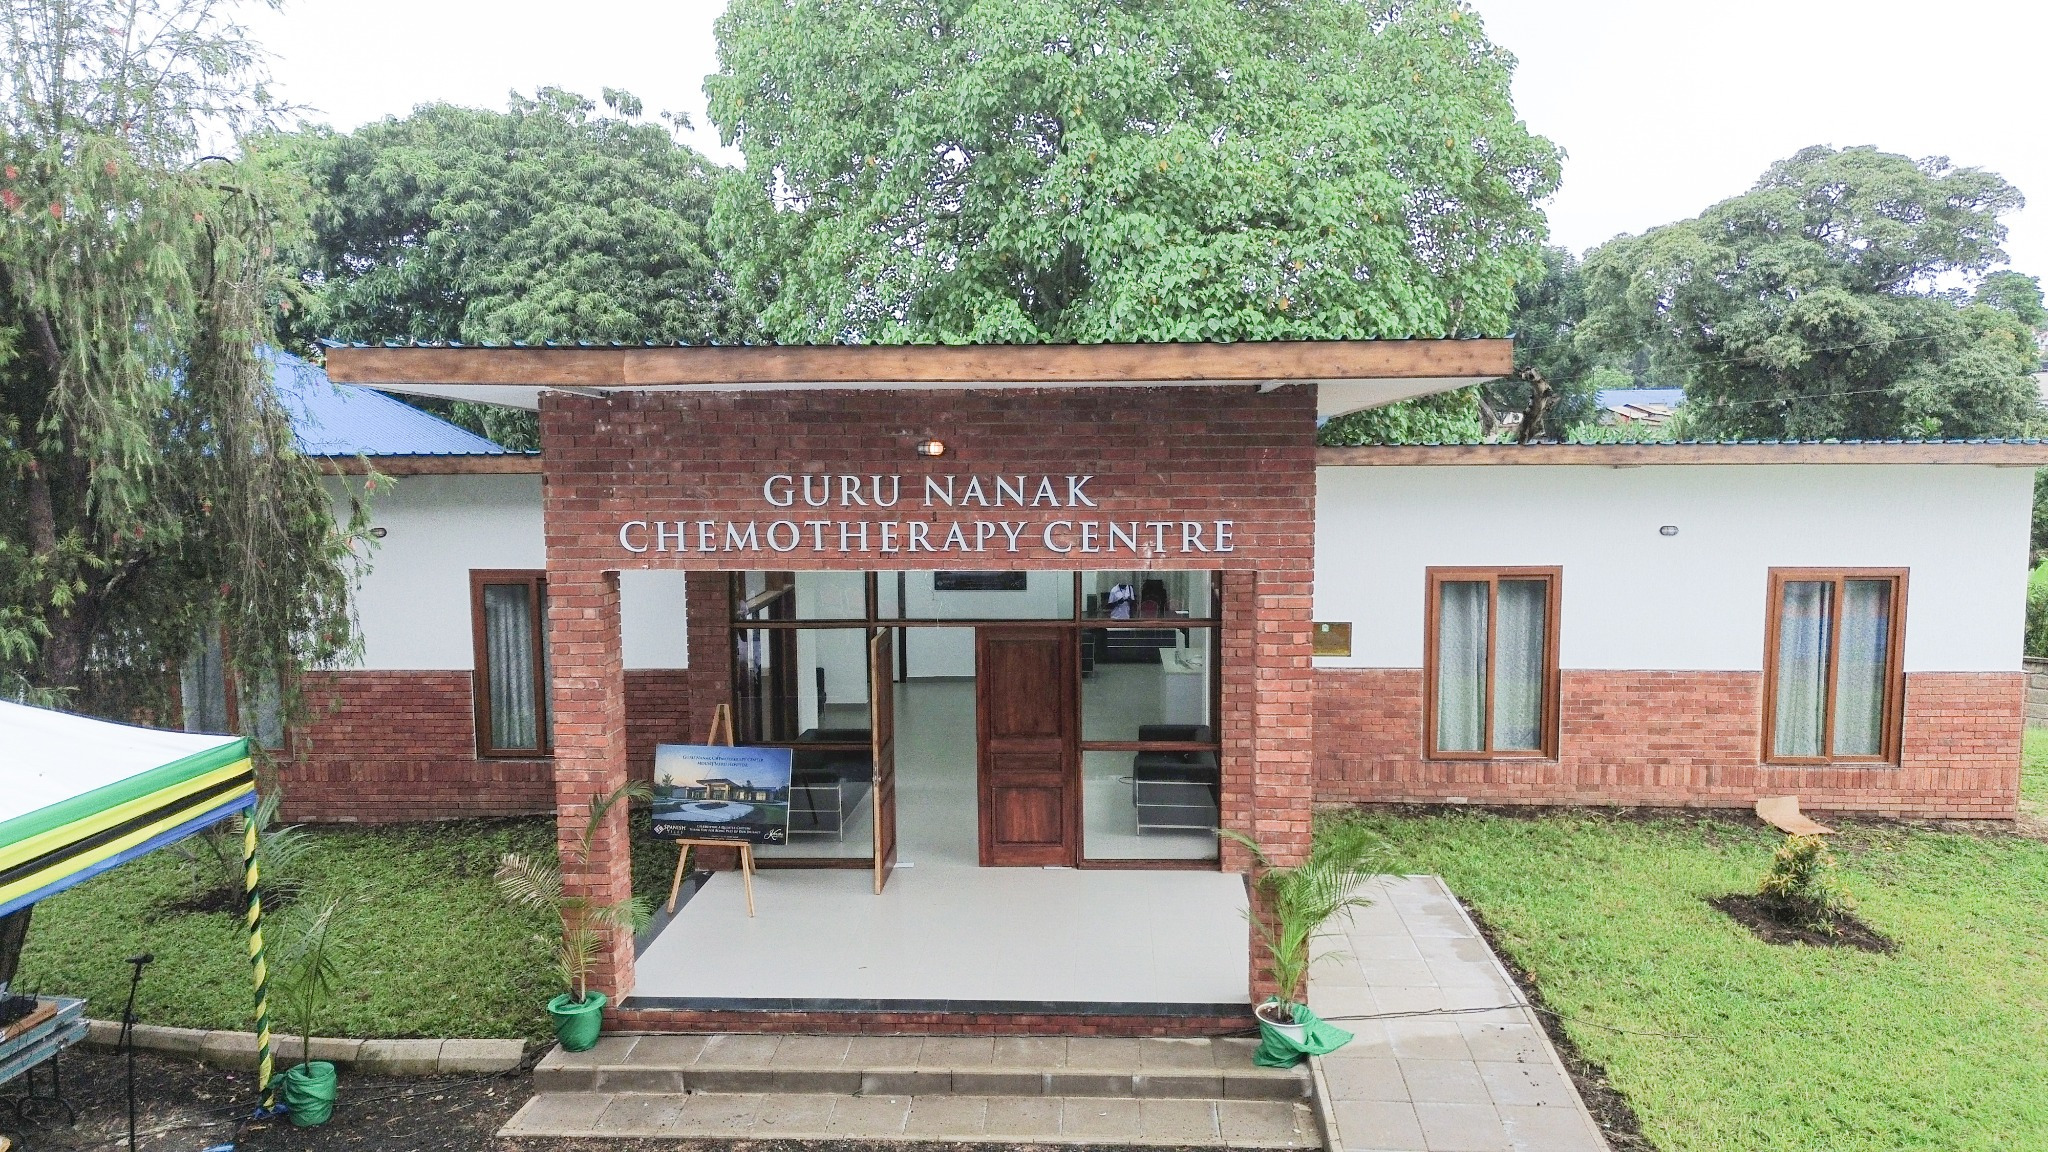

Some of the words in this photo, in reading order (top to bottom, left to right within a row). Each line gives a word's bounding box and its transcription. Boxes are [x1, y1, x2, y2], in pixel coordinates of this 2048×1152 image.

[763, 475, 901, 507] GURU
[923, 475, 1098, 507] NANAK
[619, 520, 1028, 553] CHEMOTHERAPY
[1043, 520, 1234, 553] CENTRE
